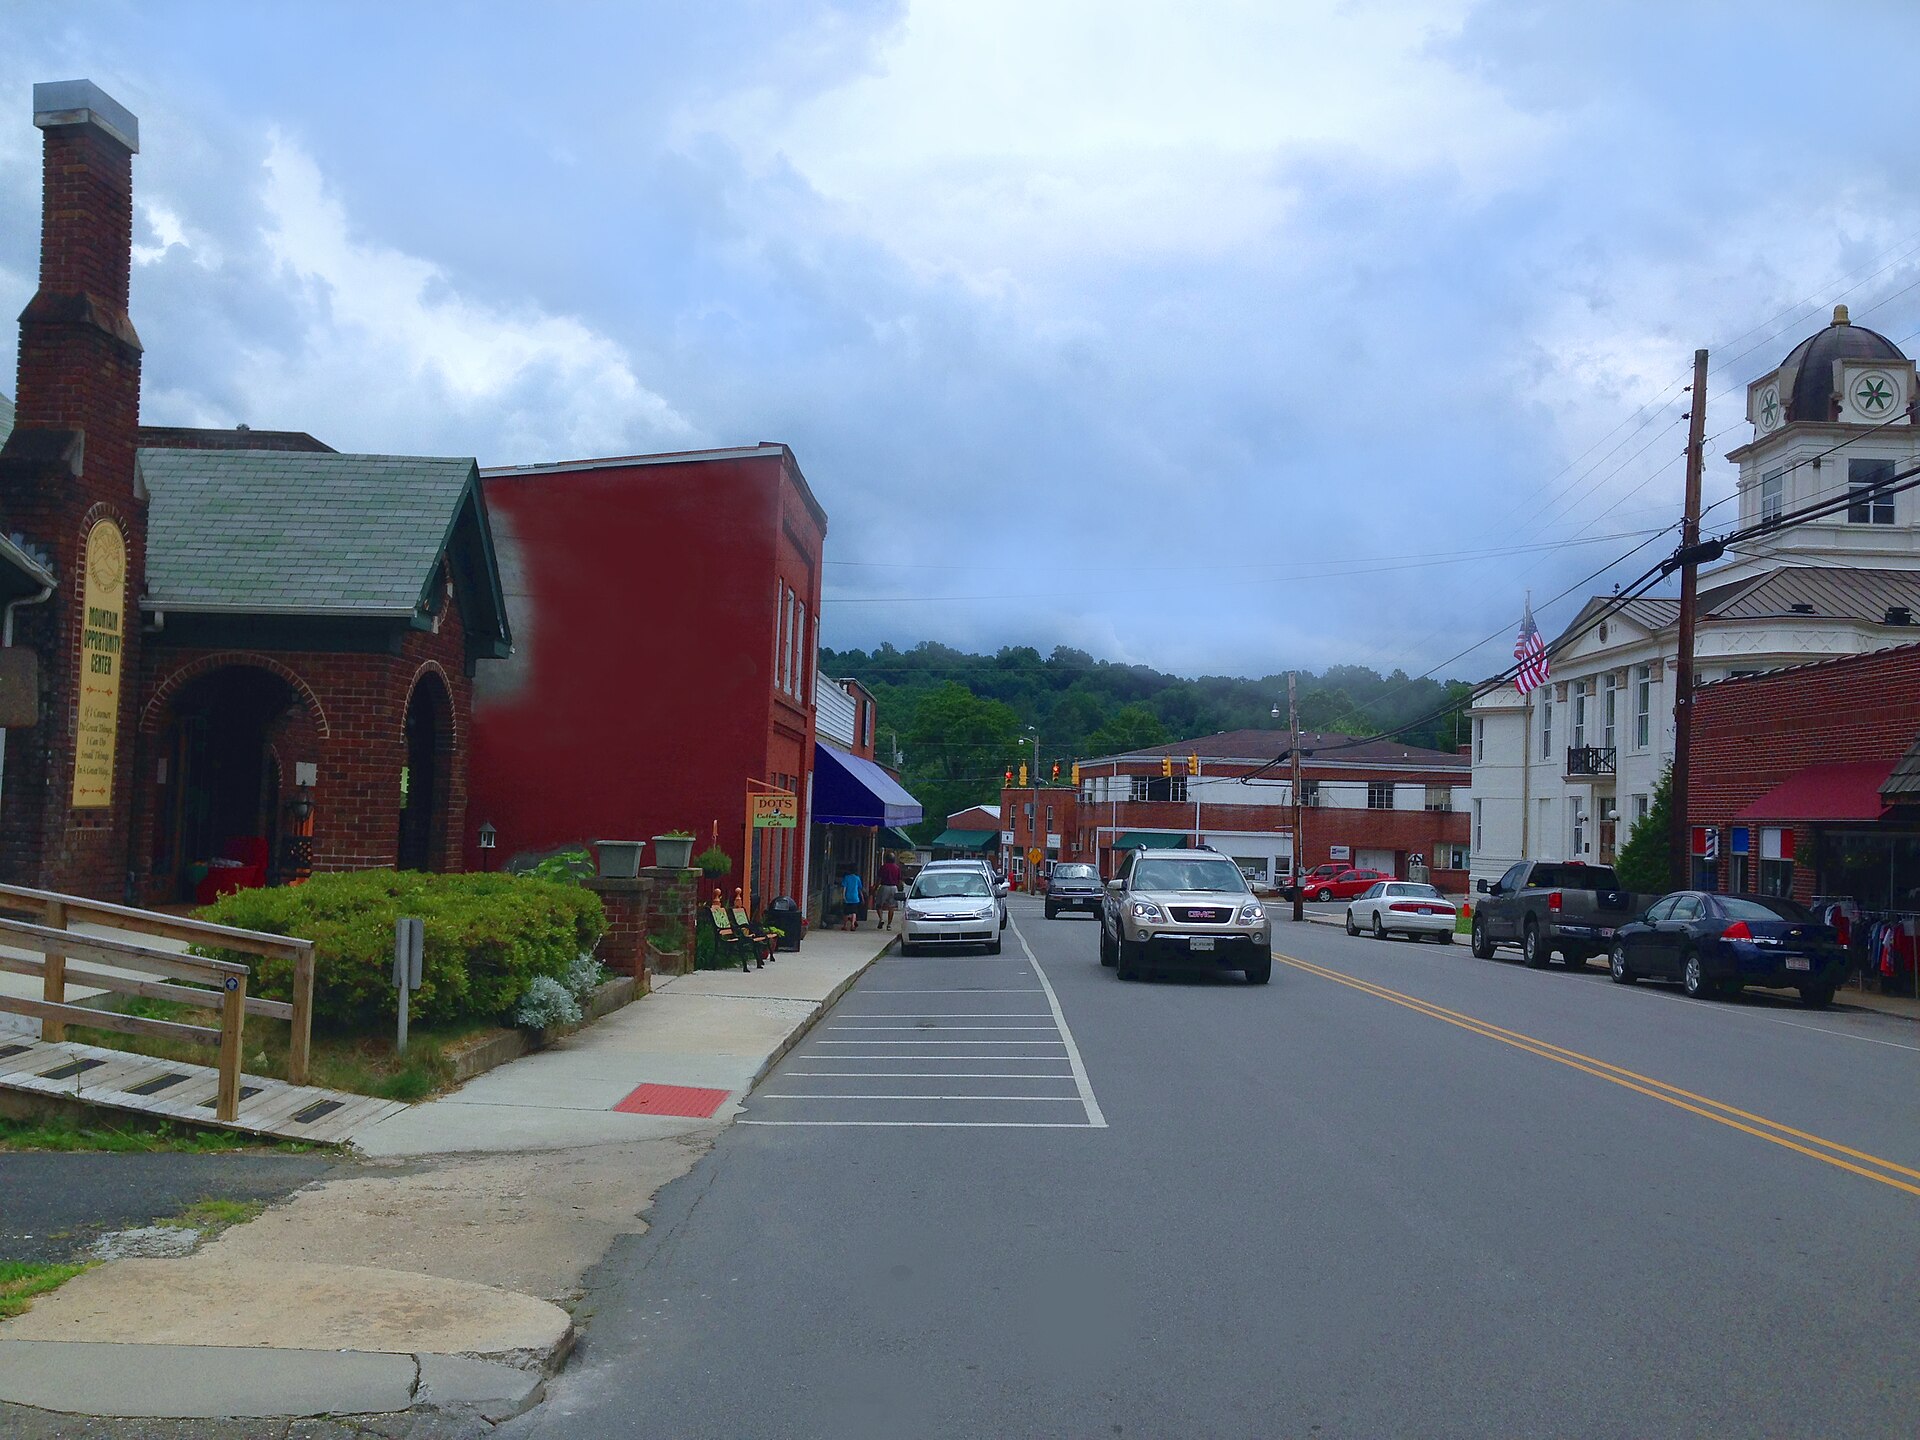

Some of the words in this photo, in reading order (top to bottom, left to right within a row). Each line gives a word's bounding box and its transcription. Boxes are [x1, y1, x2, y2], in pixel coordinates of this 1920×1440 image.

[88, 606, 118, 631] MOUNTAIN
[84, 629, 121, 655] OPPORTUNITY
[90, 653, 112, 675] CENTER
[1187, 910, 1216, 918] GMC
